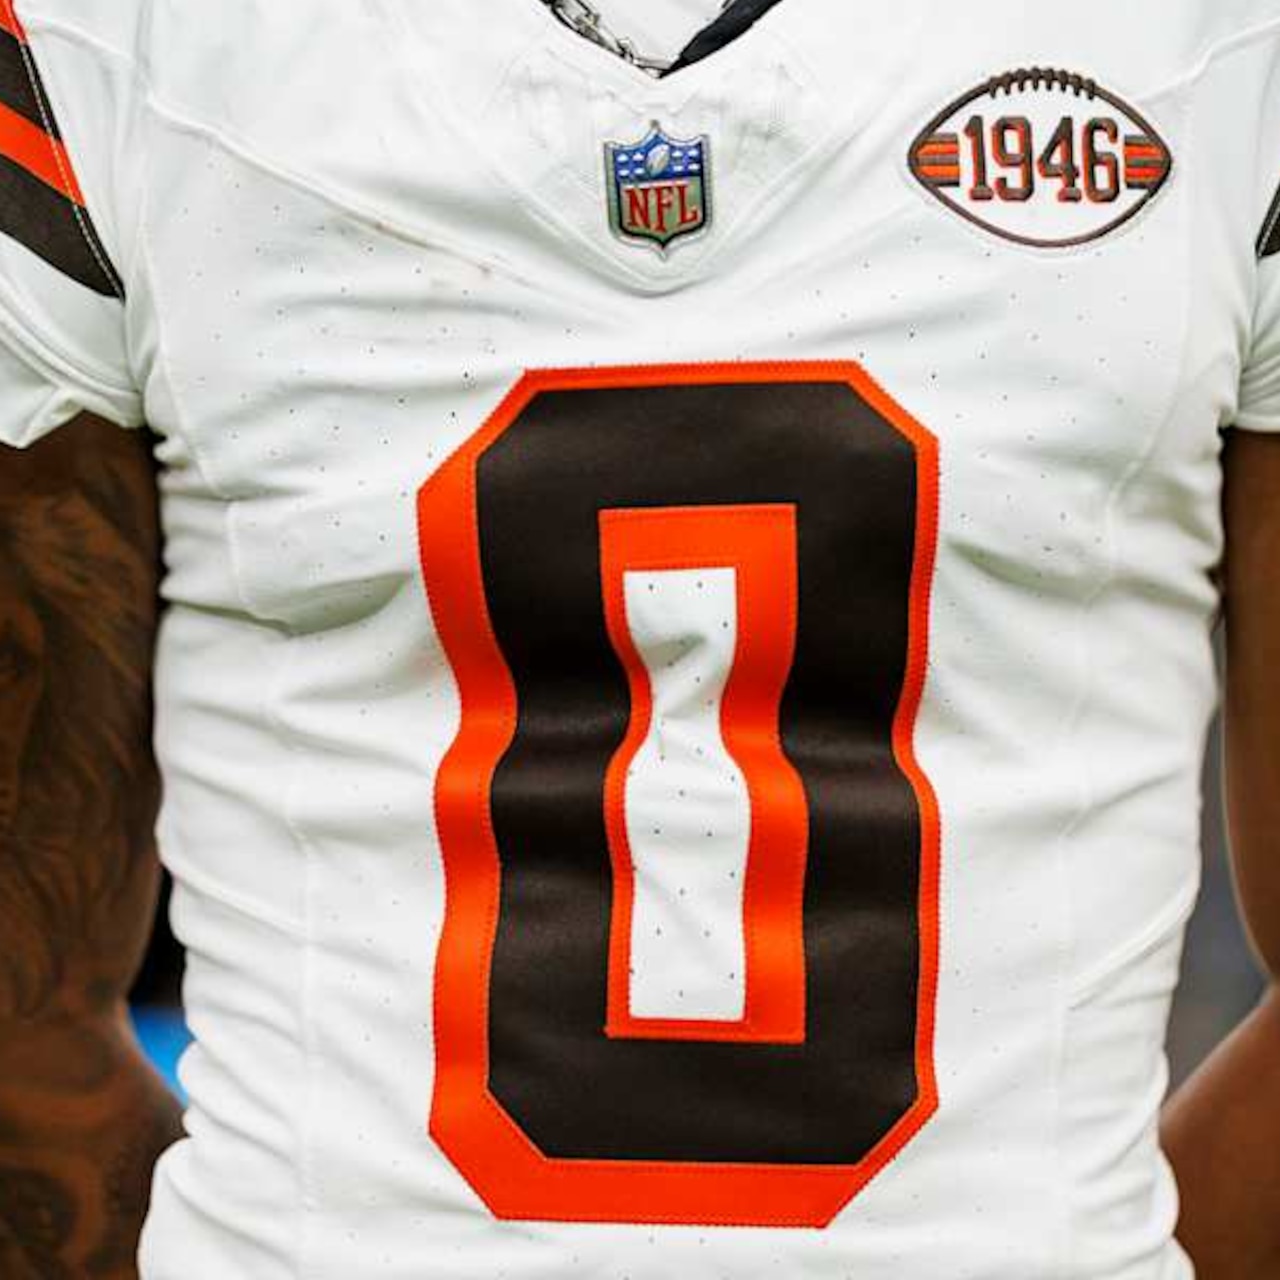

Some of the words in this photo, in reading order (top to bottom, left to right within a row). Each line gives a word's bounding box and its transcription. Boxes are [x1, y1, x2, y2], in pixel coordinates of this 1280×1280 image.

[964, 115, 1120, 203] 1946
[624, 184, 700, 234] NFL
[416, 360, 941, 1229] 0
